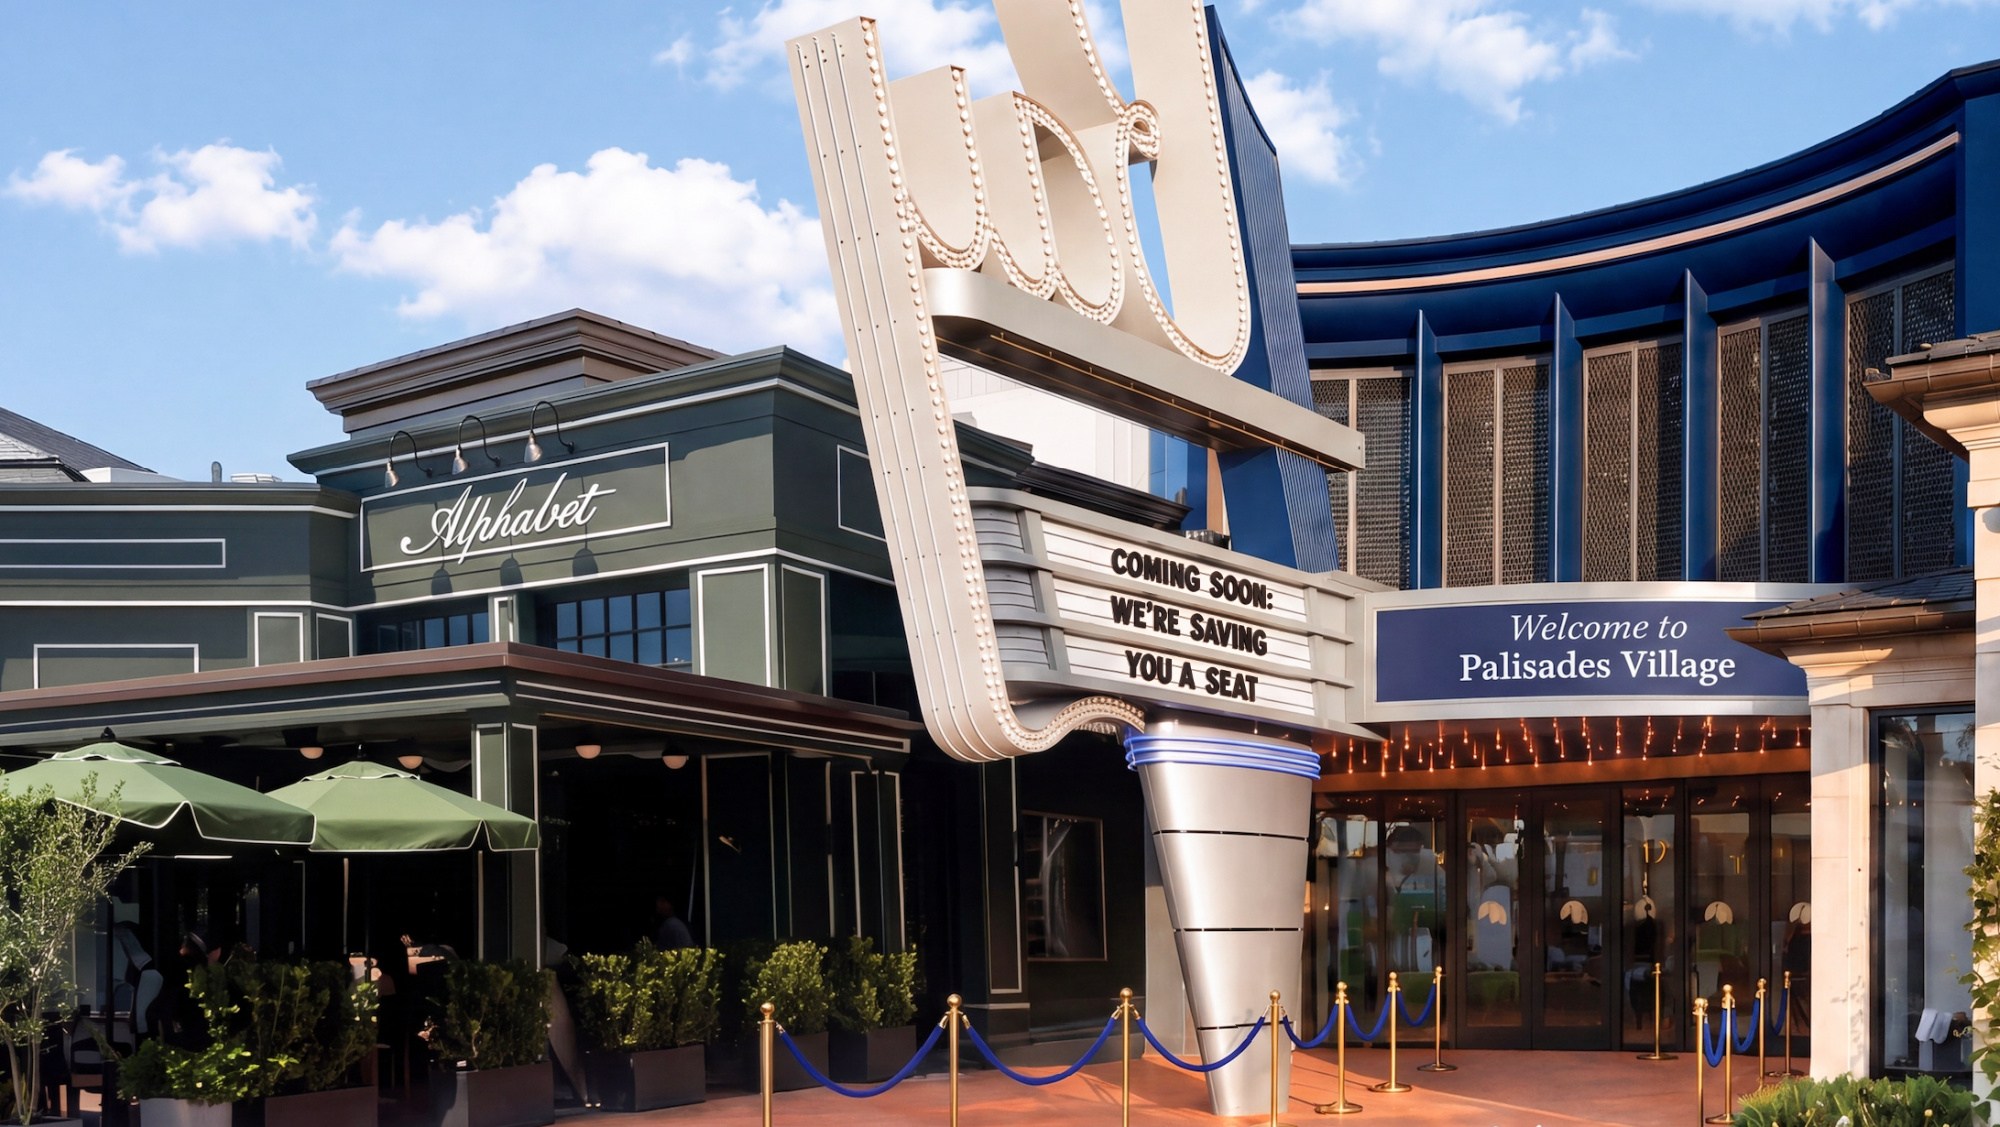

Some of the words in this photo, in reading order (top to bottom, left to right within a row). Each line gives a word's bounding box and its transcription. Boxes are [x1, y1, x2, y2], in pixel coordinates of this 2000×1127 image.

[400, 471, 617, 565] Alphabet
[1111, 548, 1201, 592] COMING
[1209, 571, 1273, 610] SOON:
[1110, 595, 1181, 636] WE'RE
[1190, 613, 1268, 656] SAVING
[1511, 612, 1649, 641] Welcome
[1658, 615, 1688, 639] to
[1125, 650, 1173, 685] YOU
[1178, 661, 1196, 690] A
[1205, 666, 1258, 702] SEAT
[1459, 650, 1611, 682] Palisades
[1620, 649, 1736, 687] Village
